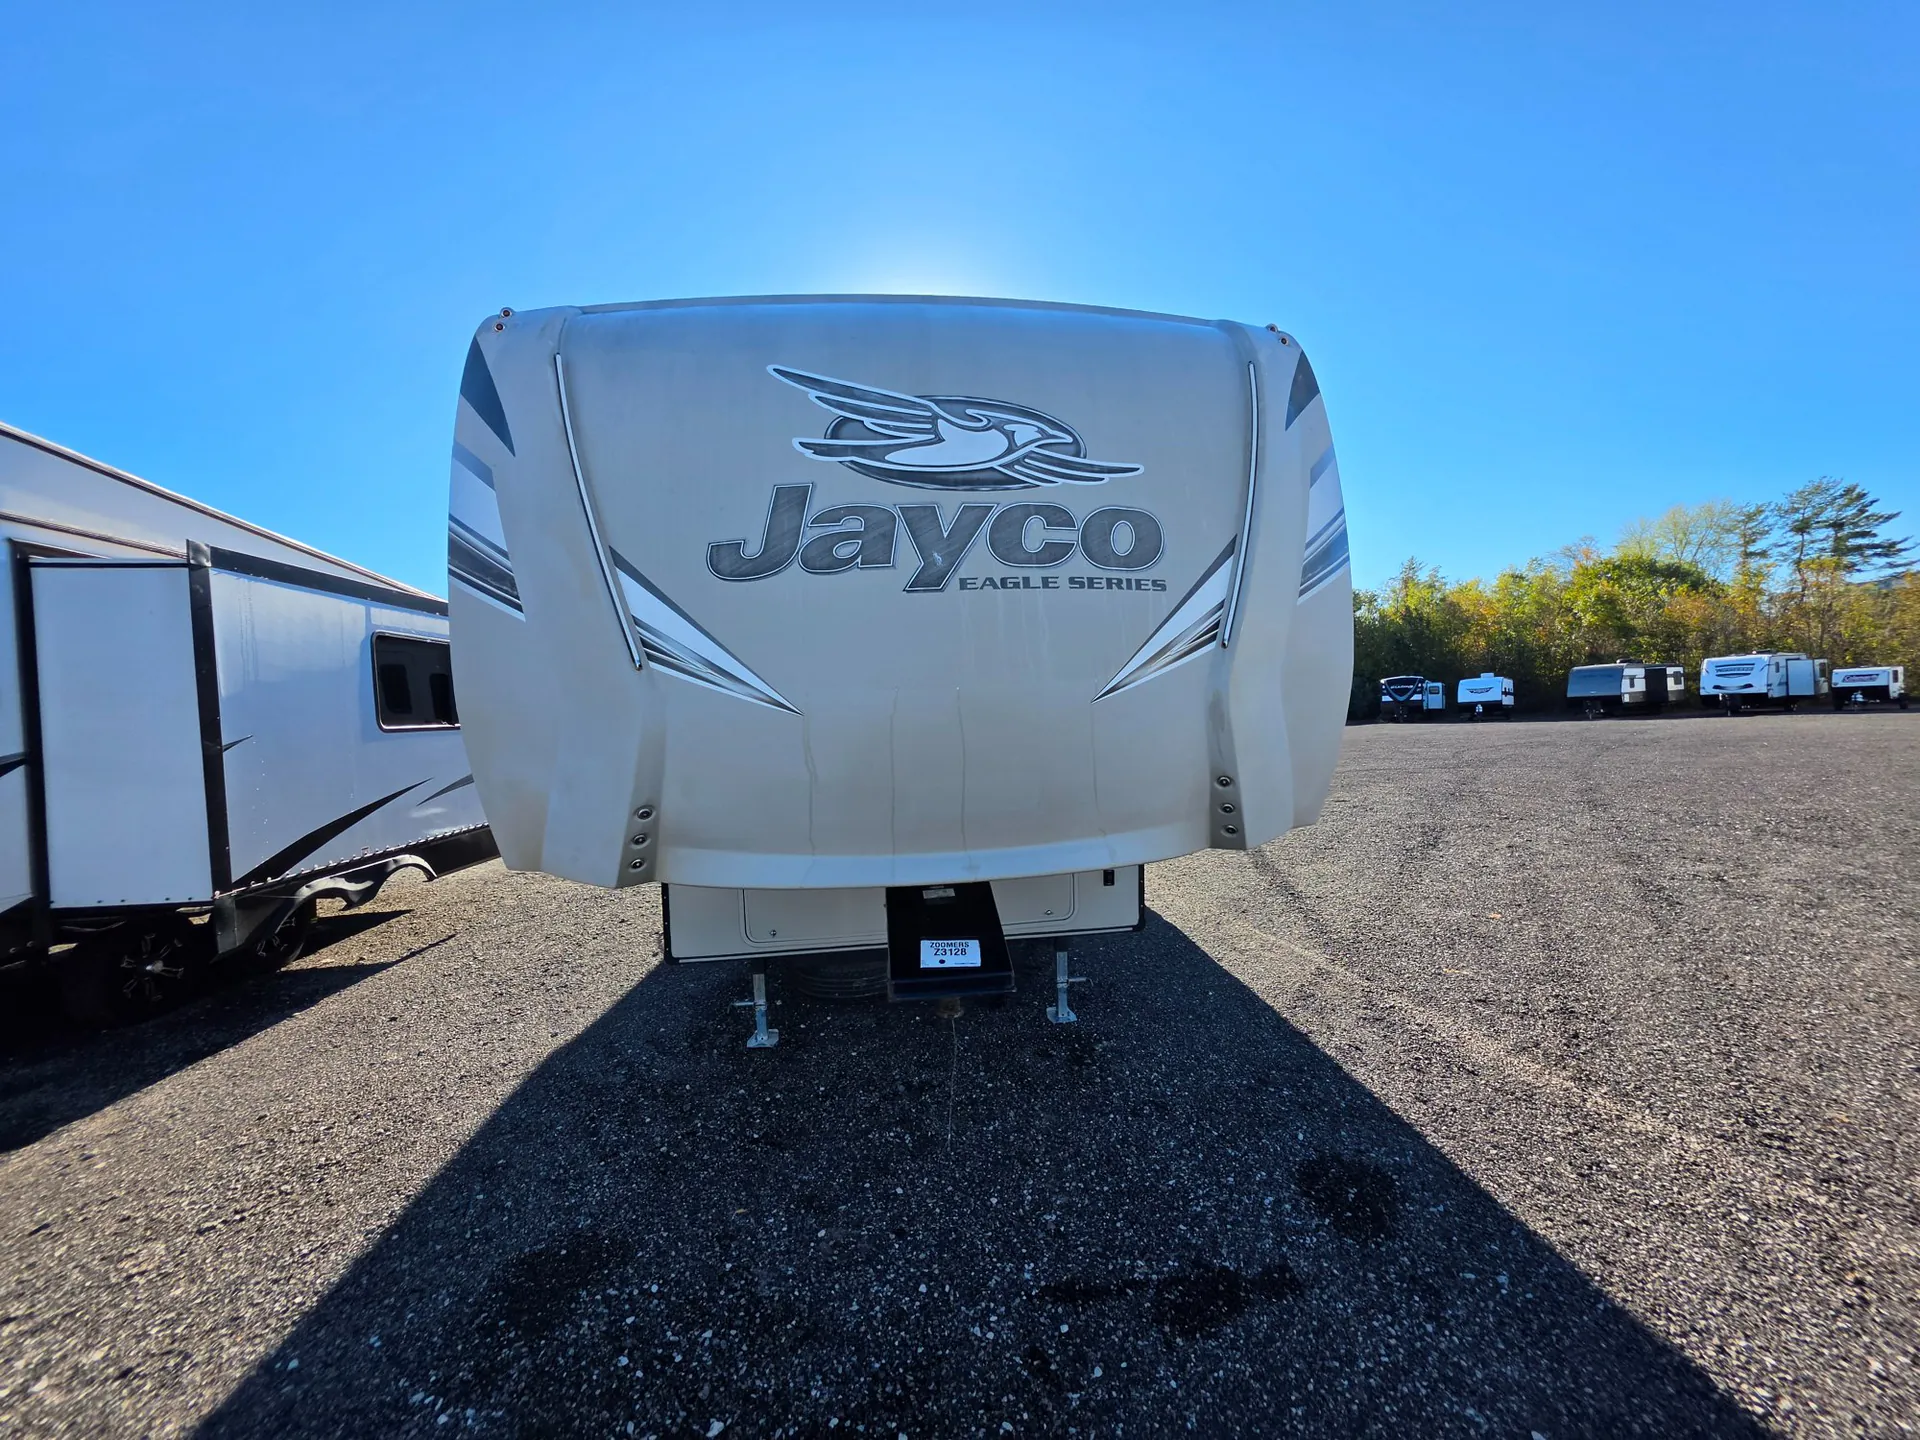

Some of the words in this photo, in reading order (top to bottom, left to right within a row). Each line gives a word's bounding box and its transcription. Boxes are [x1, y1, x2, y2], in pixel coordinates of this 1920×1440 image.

[706, 482, 1166, 593] Jayco
[958, 576, 1060, 591] EAGLE
[1068, 576, 1167, 592] SERIES
[933, 947, 968, 956] Z3128
